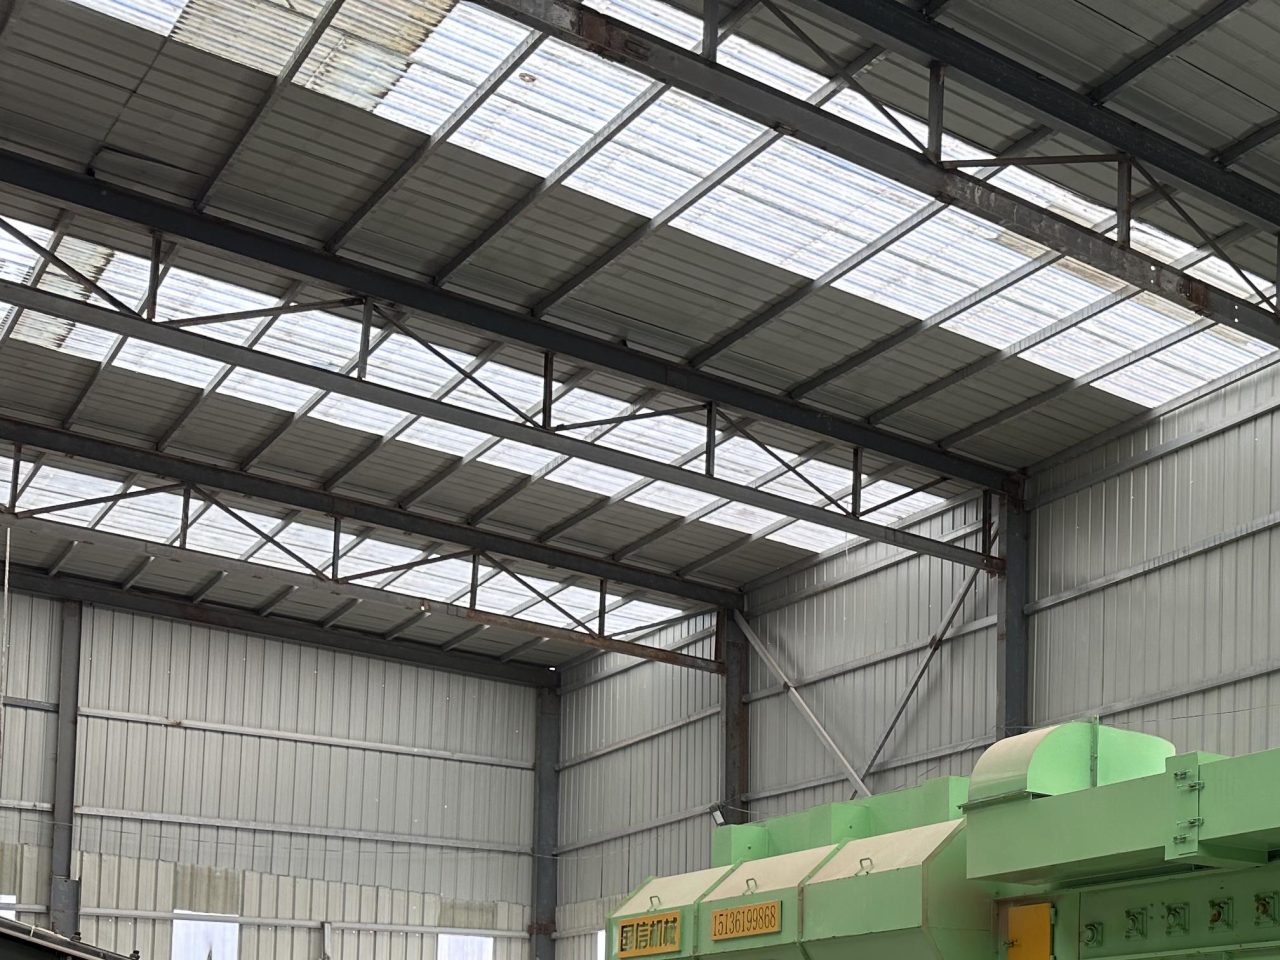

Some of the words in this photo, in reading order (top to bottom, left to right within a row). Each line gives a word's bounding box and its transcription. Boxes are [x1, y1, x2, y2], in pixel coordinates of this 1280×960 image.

[620, 917, 678, 951] 国信机械
[713, 904, 776, 937] 15136199868
